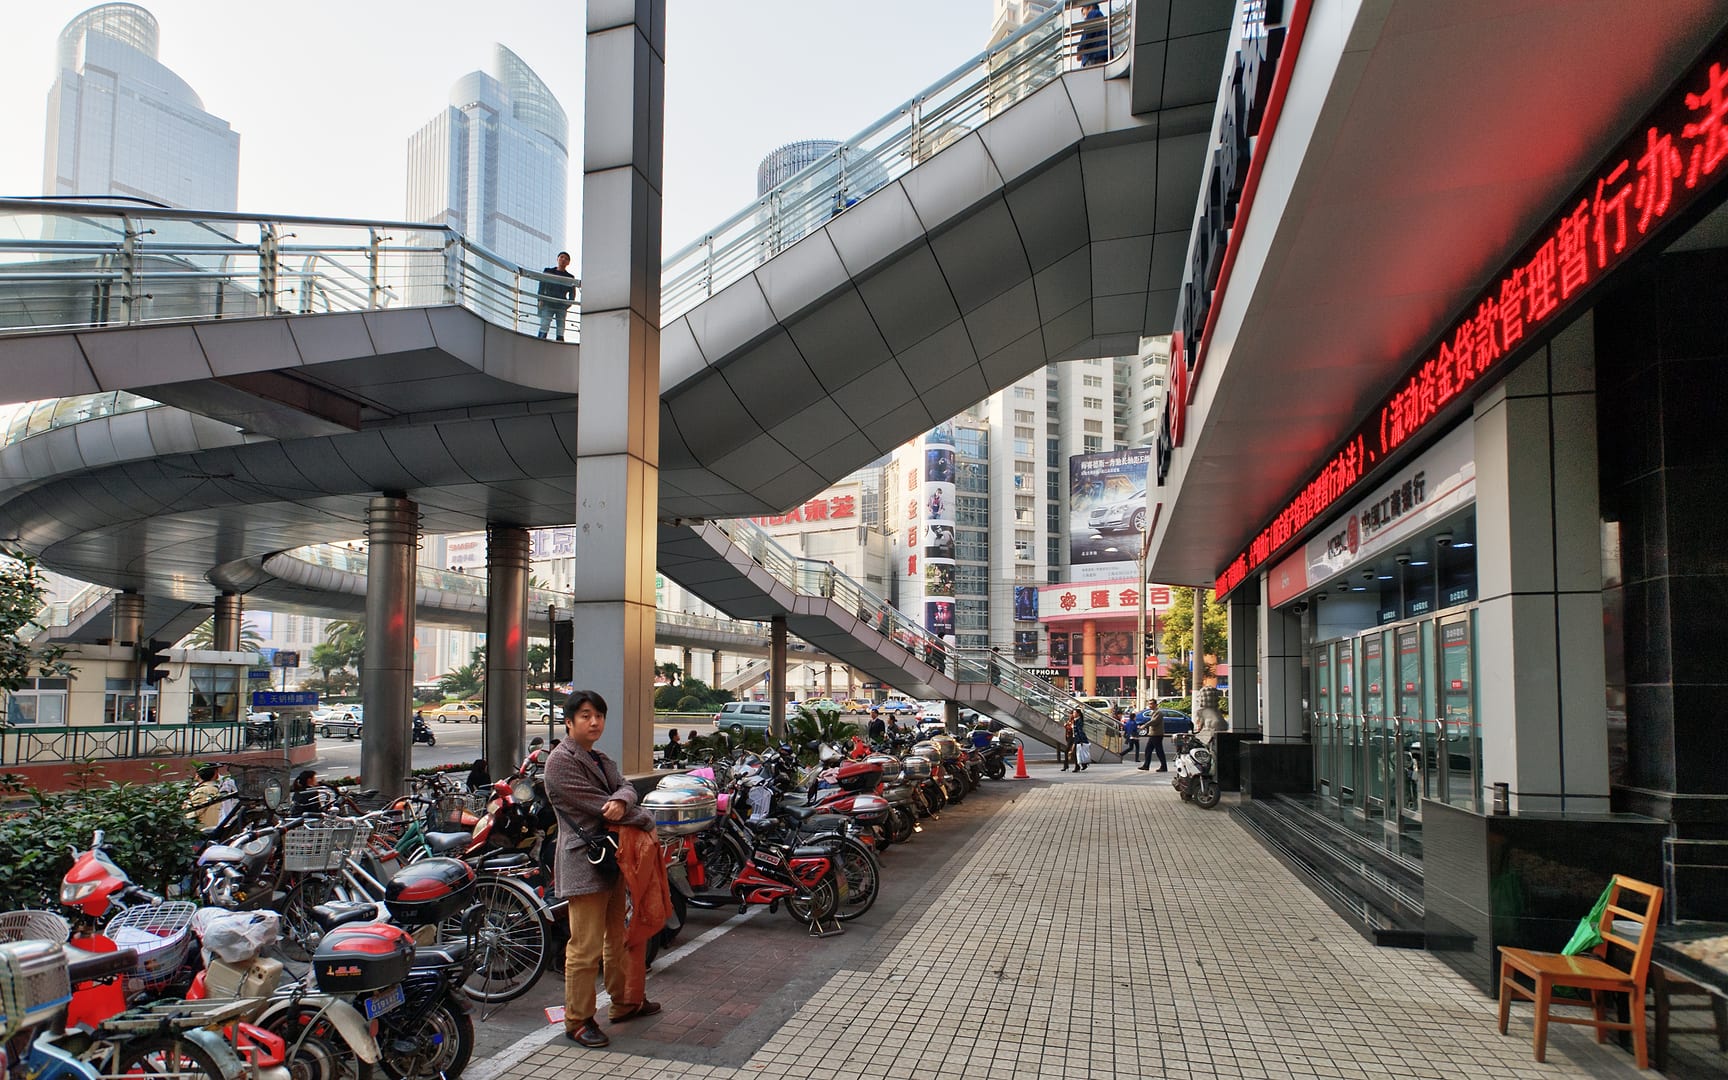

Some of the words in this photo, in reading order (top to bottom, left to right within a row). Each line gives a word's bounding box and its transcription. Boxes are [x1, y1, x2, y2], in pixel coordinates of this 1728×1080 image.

[804, 495, 855, 522] 東芝
[1361, 471, 1425, 537] 中国工商银行
[448, 541, 478, 552] SHARP
[1027, 668, 1060, 677] SEPHORA
